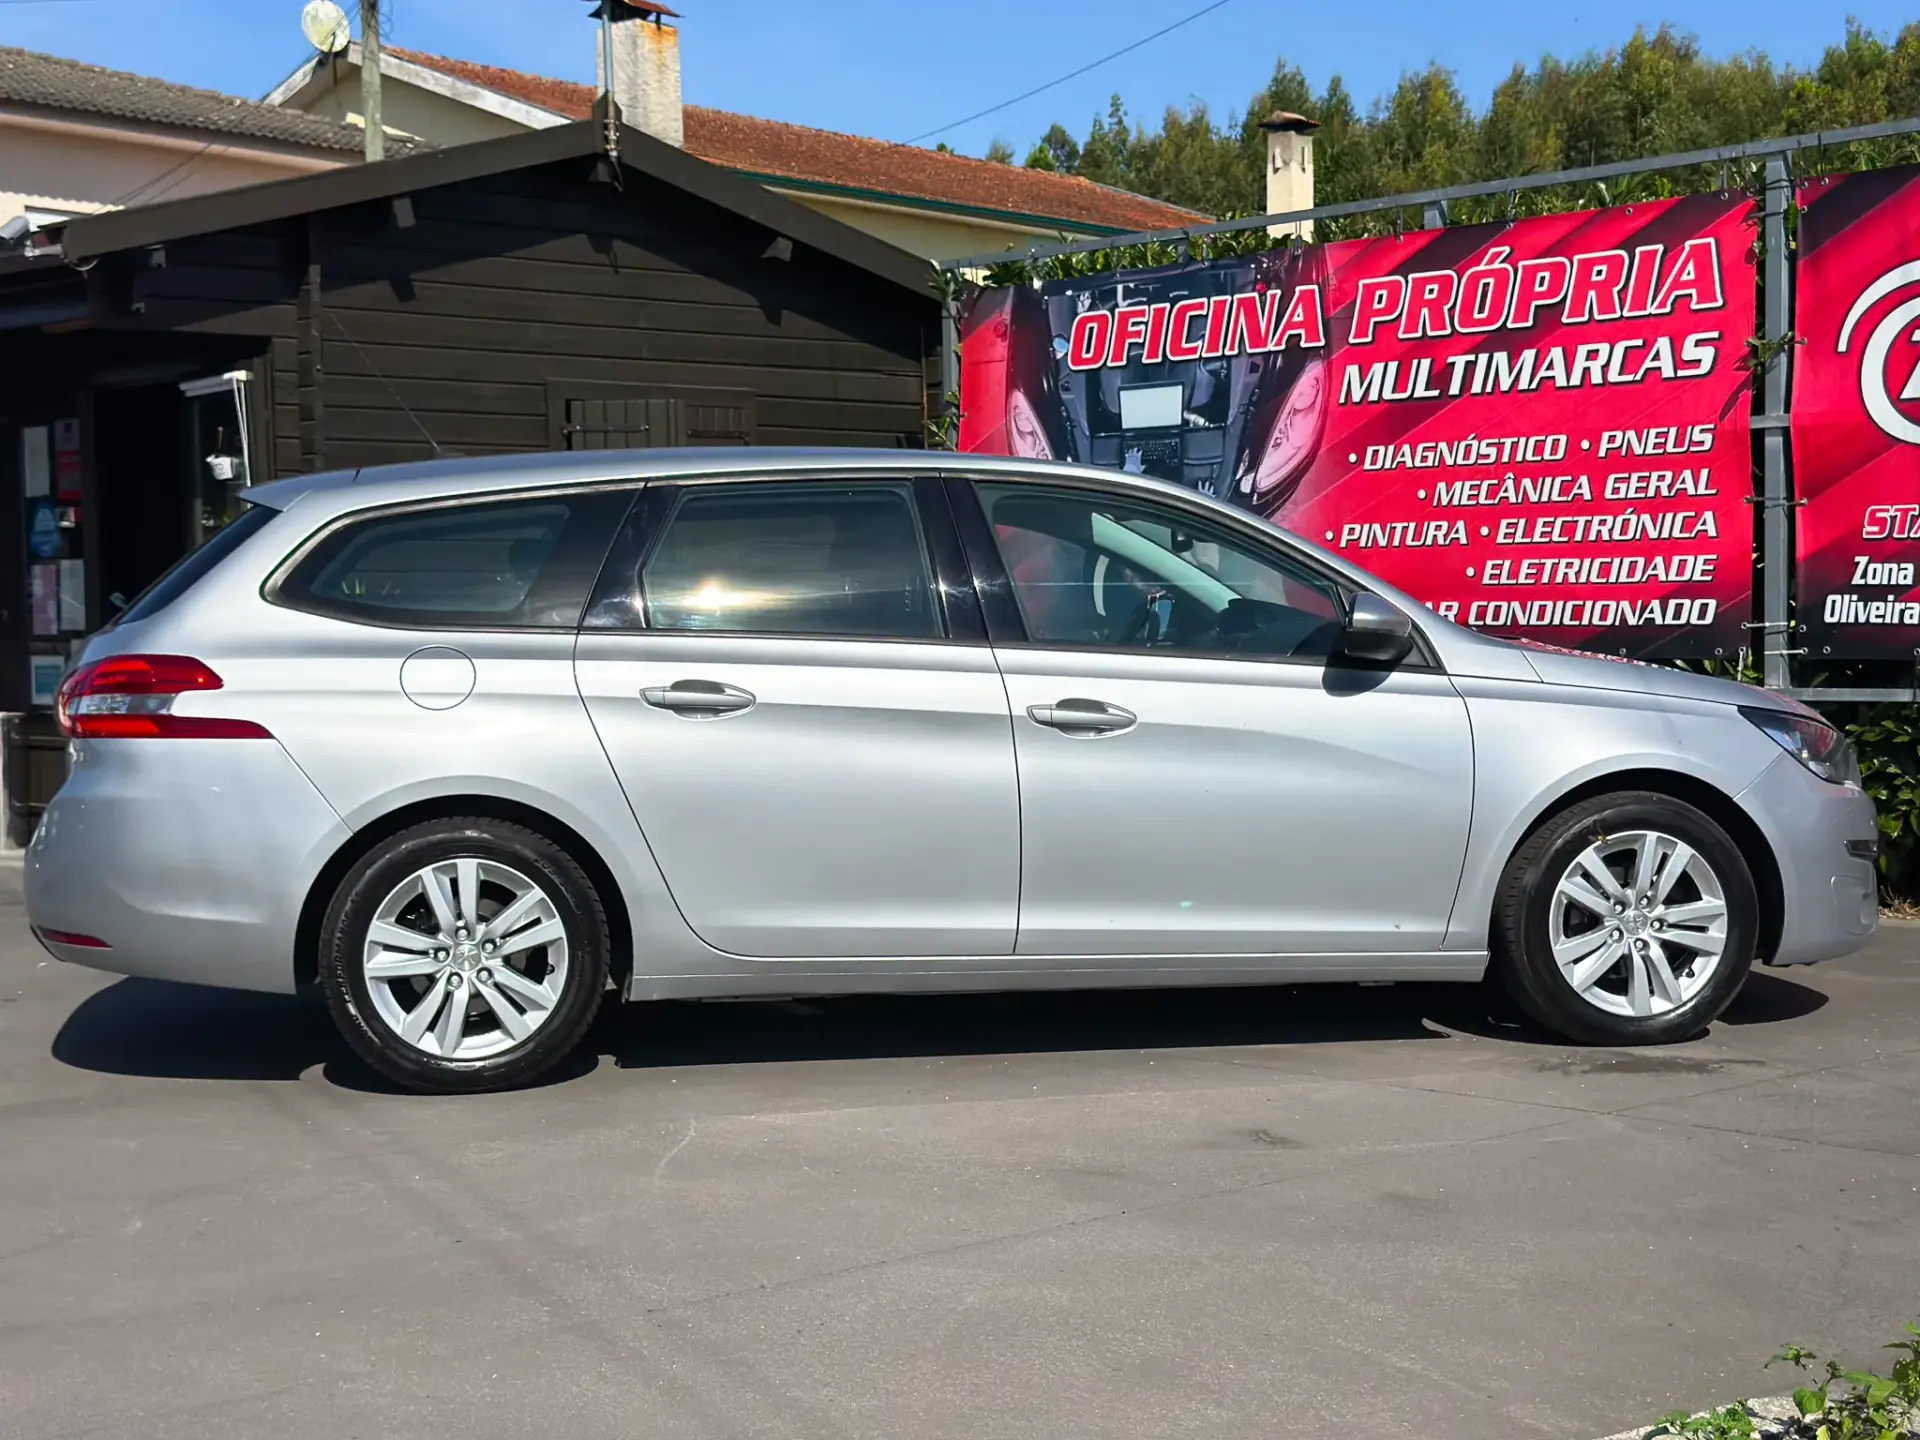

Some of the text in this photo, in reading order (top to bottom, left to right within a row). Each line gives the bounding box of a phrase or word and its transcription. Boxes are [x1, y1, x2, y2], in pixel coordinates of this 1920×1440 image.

[1068, 237, 1723, 370] OFICINA PRÓPRIA
[1338, 331, 1721, 405] MULTIMARCAS
[1362, 423, 1715, 470] DIAGNÓSTICO PNEUS
[1432, 467, 1718, 507] MECÂNICA GERAL
[1339, 507, 1718, 549] PINTURA ELECTRÓNICA
[1481, 554, 1718, 586] ELETRICIDADE
[1851, 555, 1914, 585] Zona
[1467, 599, 1718, 626] CONDICIONADO
[1823, 594, 1919, 625] Oliveira
